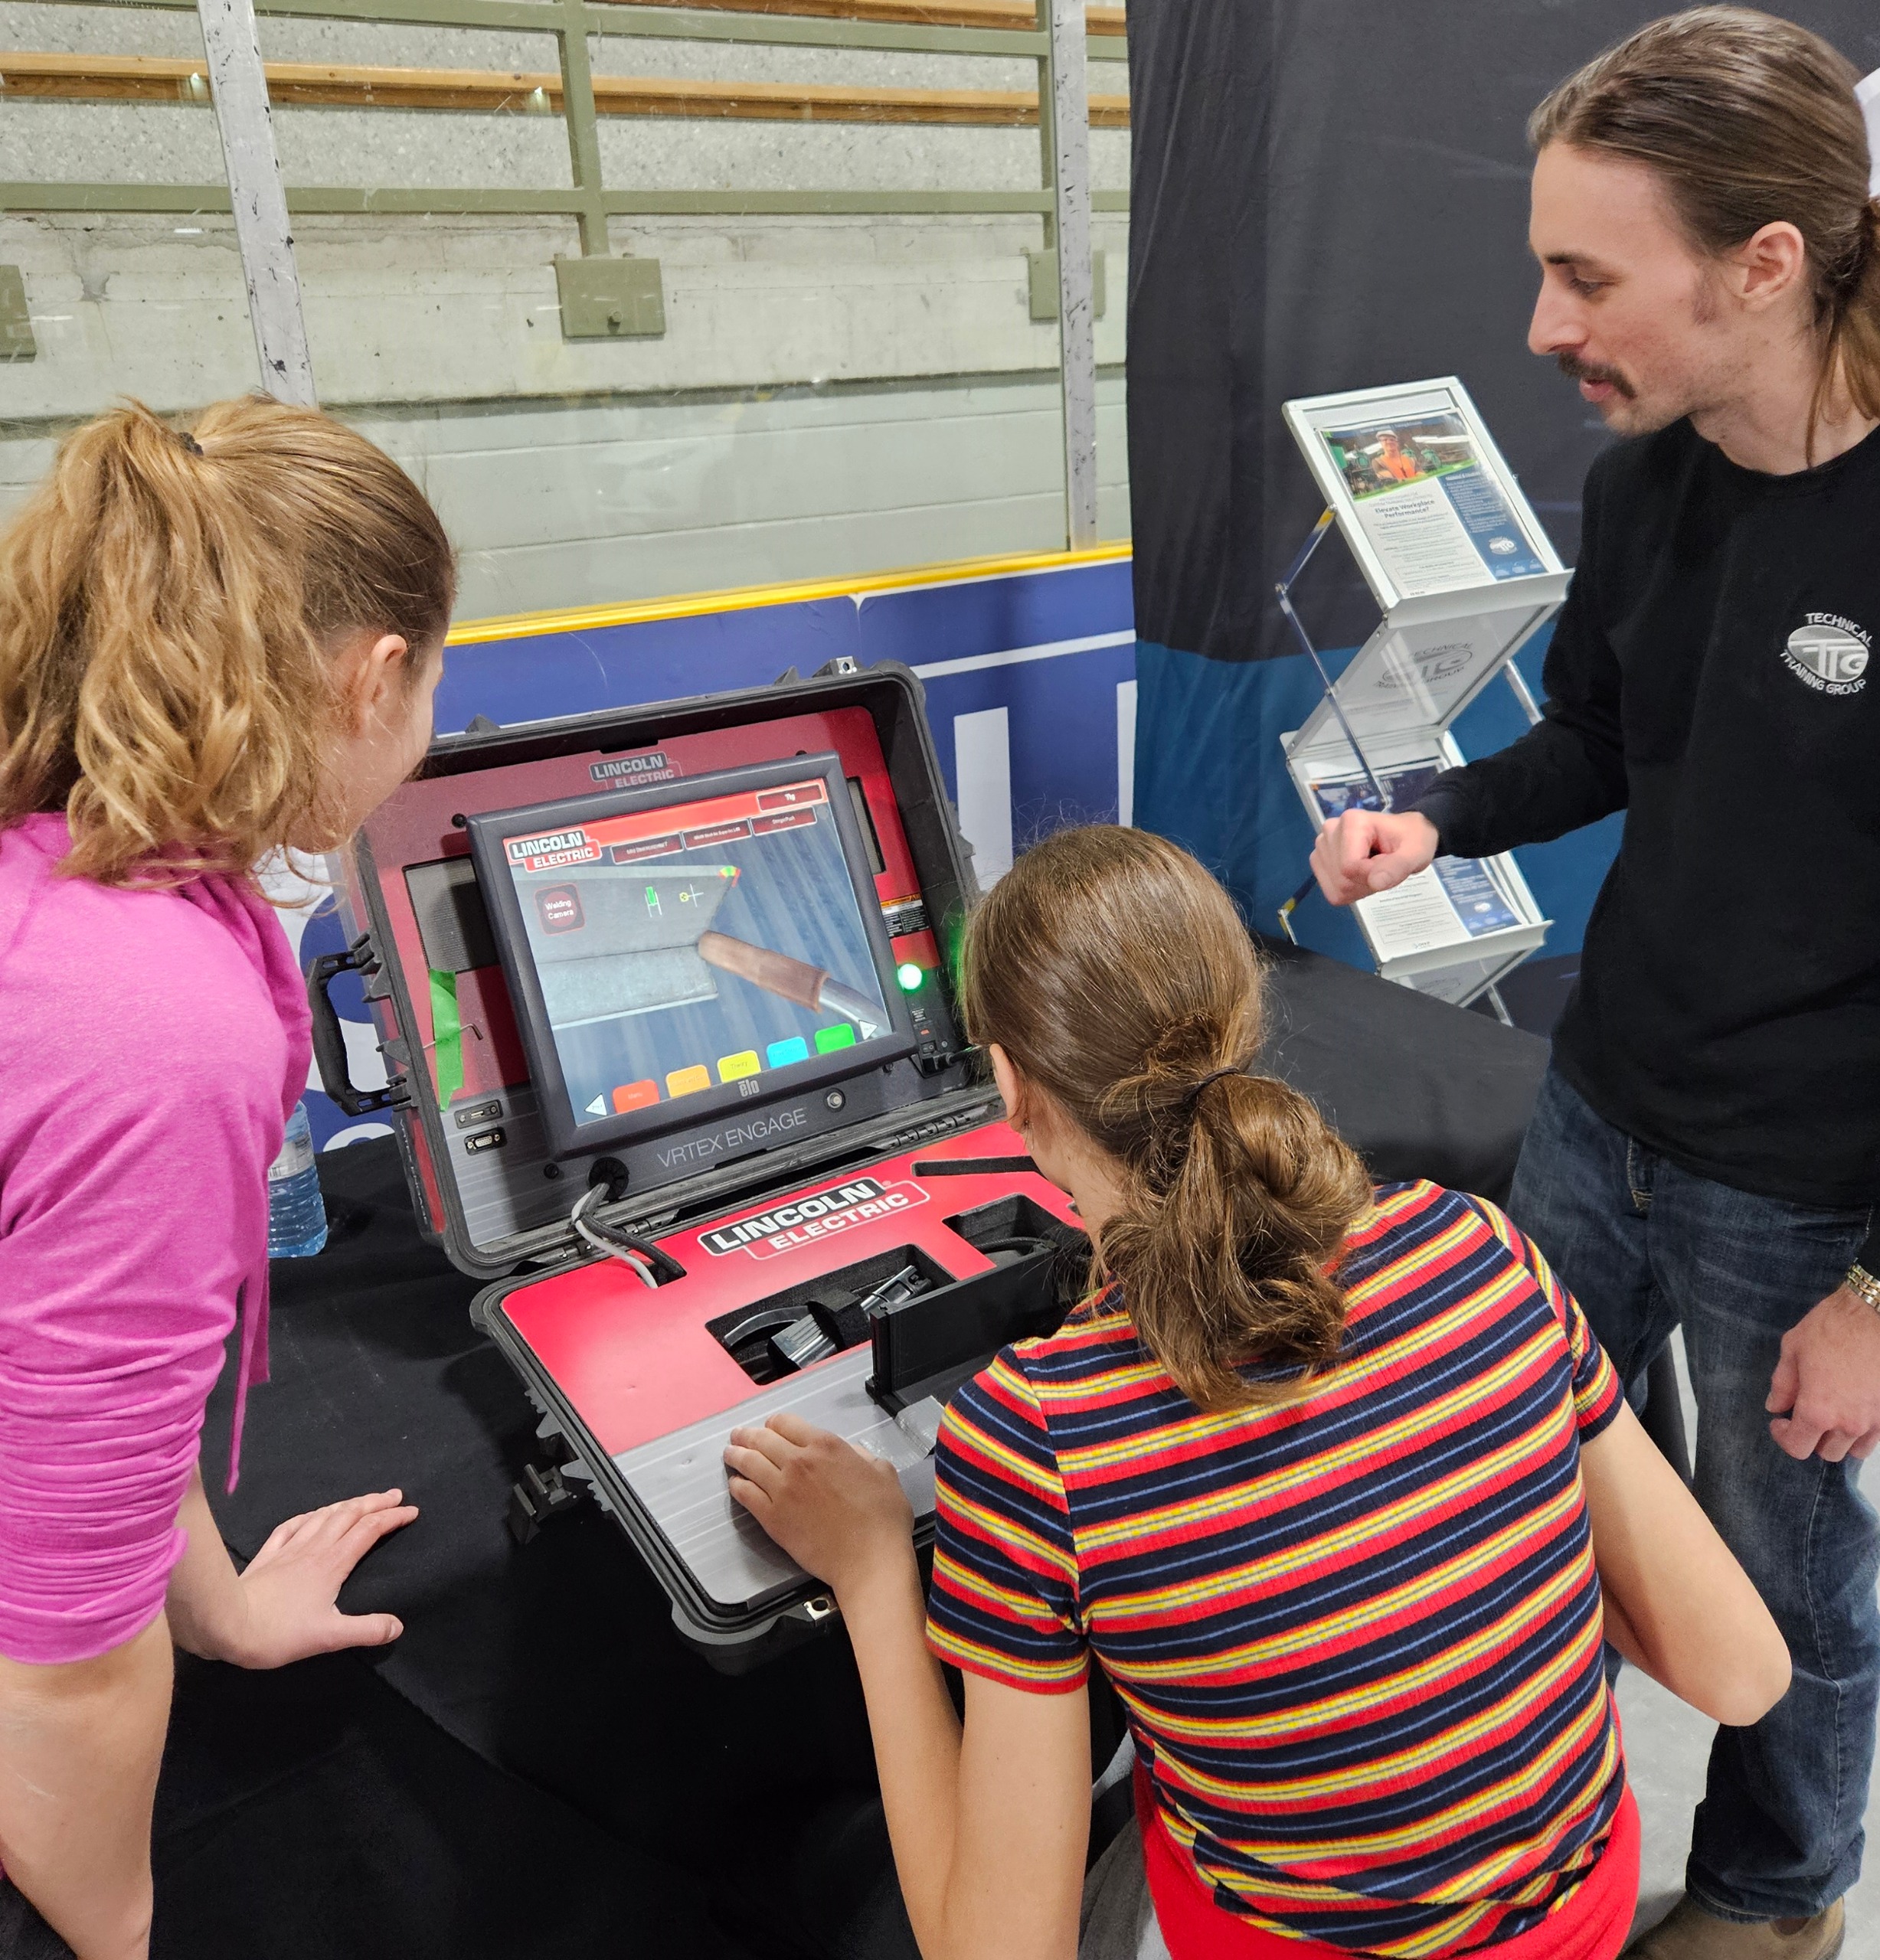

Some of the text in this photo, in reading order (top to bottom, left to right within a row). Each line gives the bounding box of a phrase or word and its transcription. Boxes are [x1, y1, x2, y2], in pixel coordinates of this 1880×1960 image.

[1375, 500, 1436, 514] Elevate Workplace
[1384, 507, 1430, 518] Performance?
[1804, 612, 1873, 648] TECHNICAL
[1780, 649, 1867, 695] TRAINING GROUP
[594, 755, 663, 779] LINCOLN
[615, 769, 675, 788] ELECTRIC
[512, 831, 584, 858] LINCOLN
[533, 847, 594, 868] ELECTRIC
[545, 900, 571, 911] Welding
[548, 909, 574, 920] Camera
[726, 1108, 807, 1148] ENGAGE
[710, 1182, 876, 1250] LINCOLN
[768, 1193, 909, 1250] ELECTRIC
